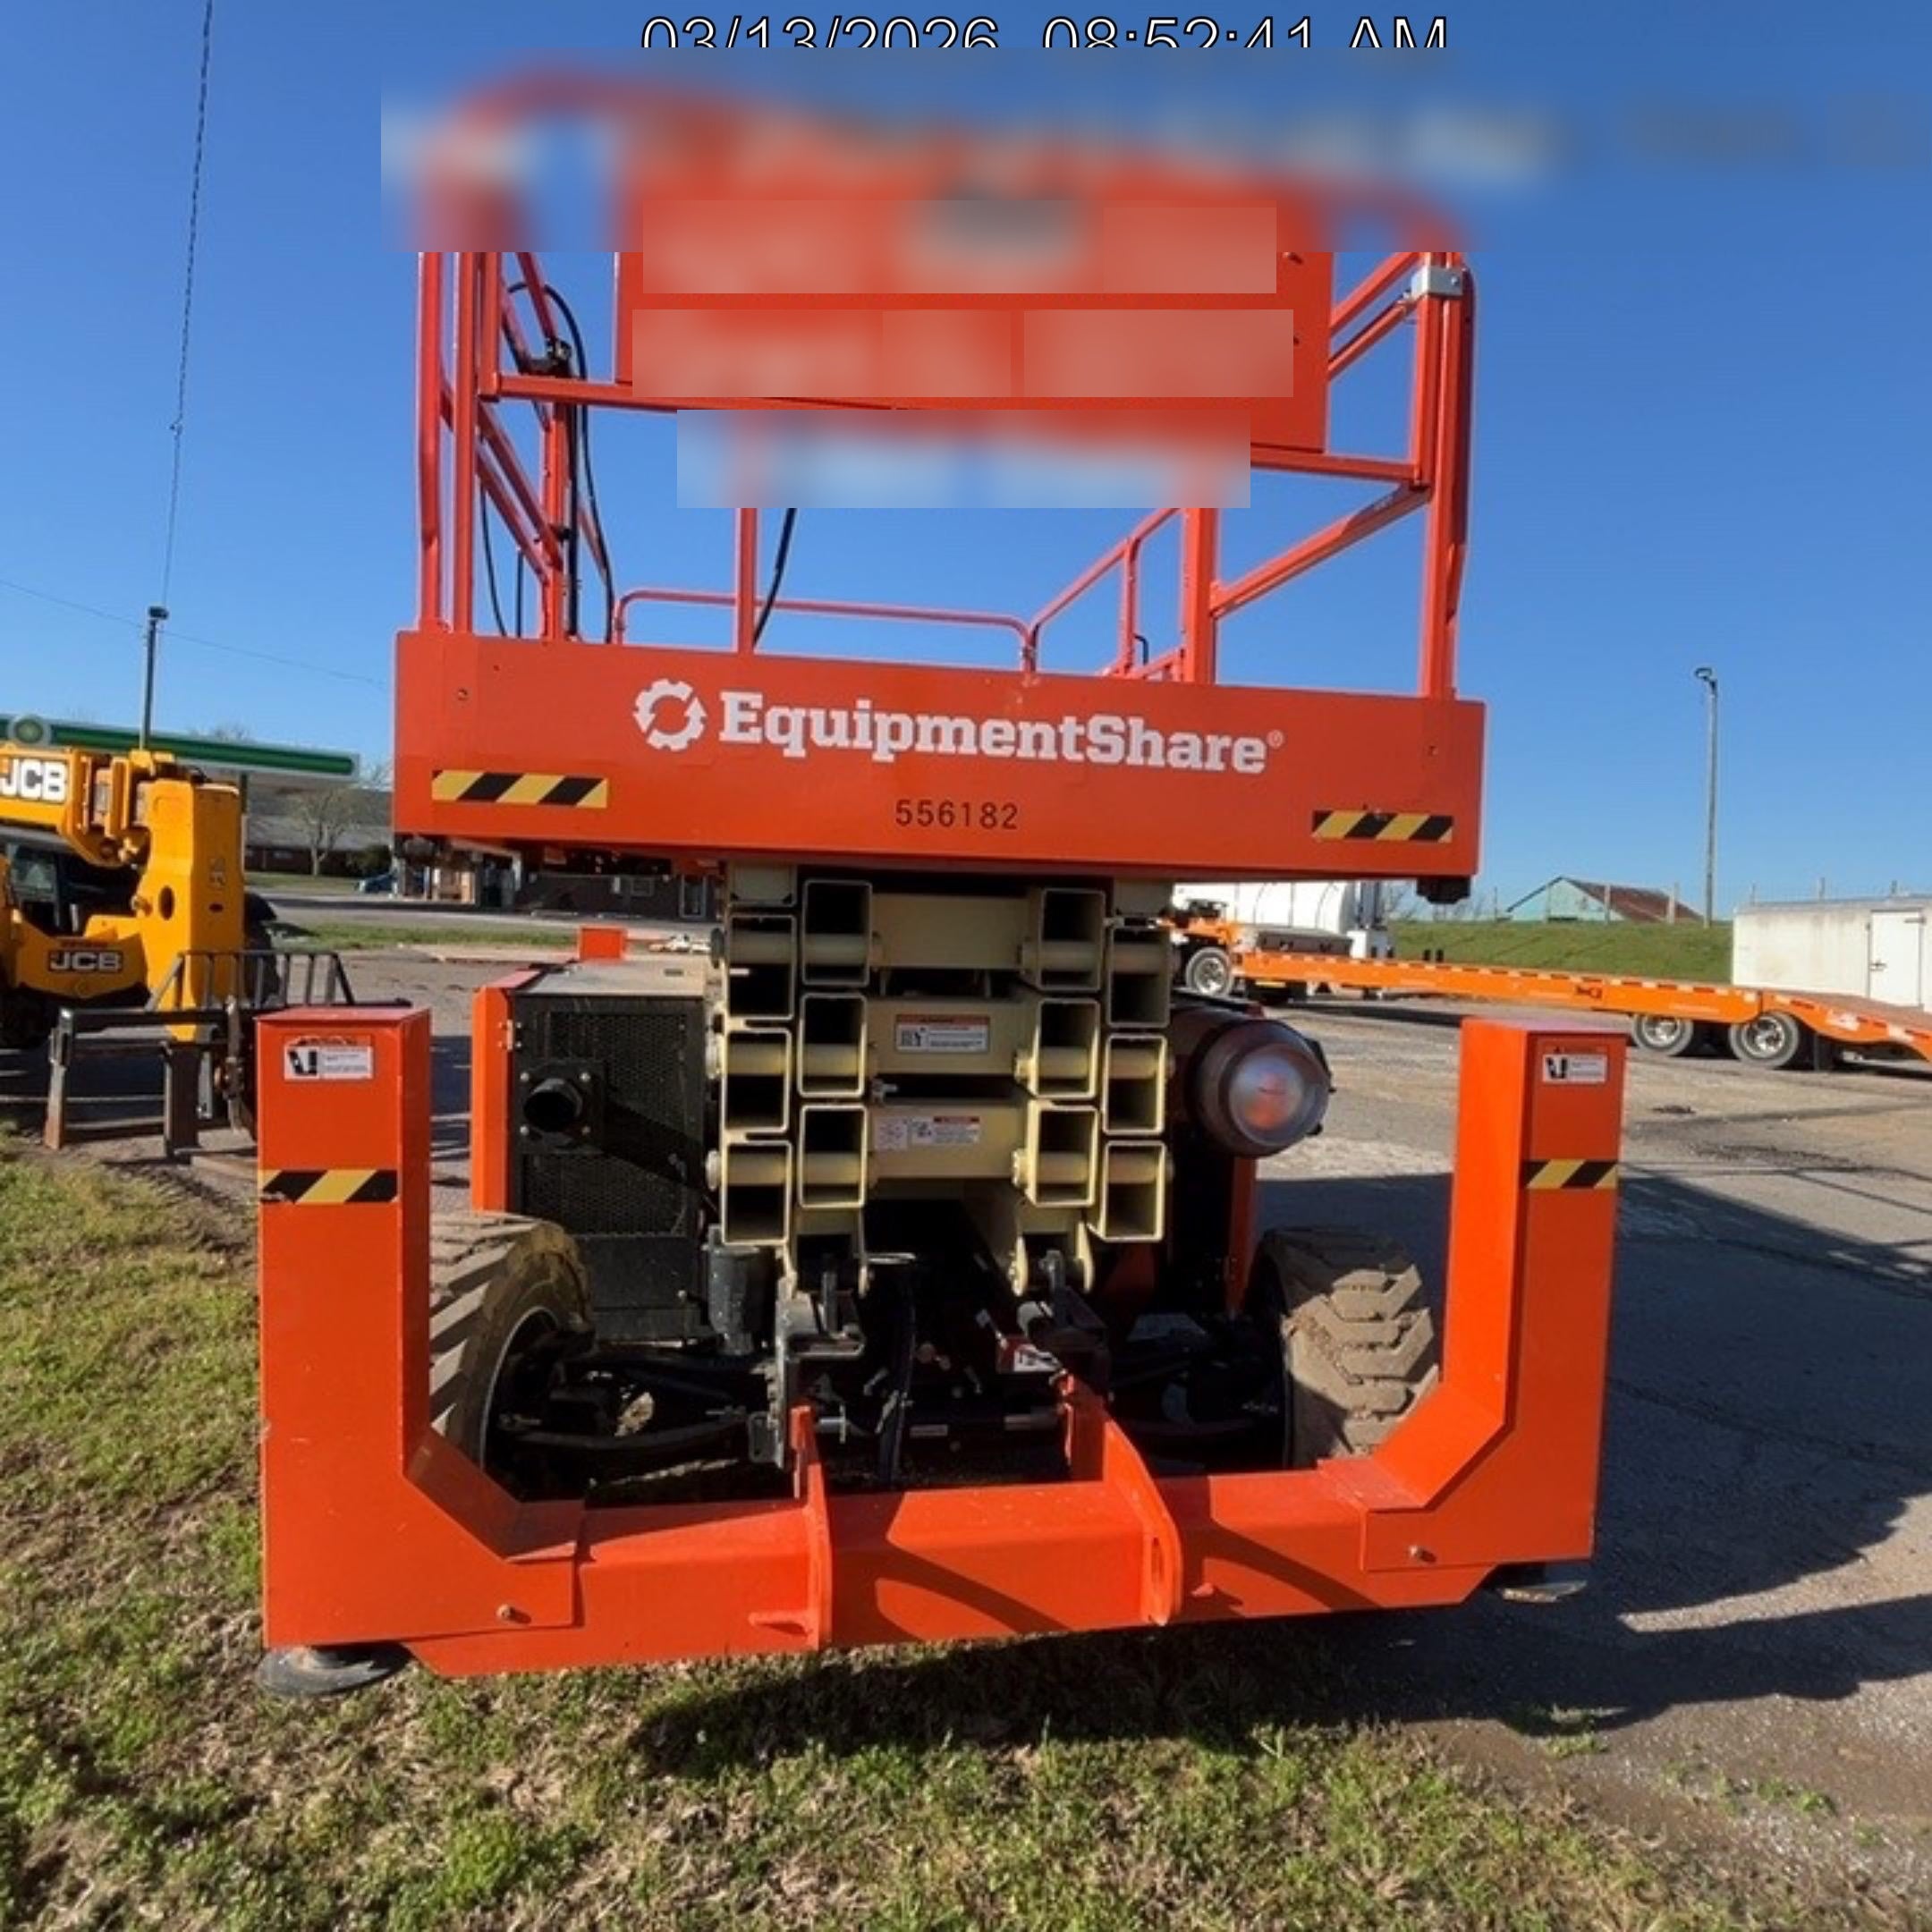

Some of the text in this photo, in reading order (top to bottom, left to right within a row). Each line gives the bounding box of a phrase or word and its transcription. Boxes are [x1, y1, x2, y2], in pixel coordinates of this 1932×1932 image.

[0, 758, 68, 802] JCB
[894, 798, 1018, 830] 556182
[50, 951, 122, 971] JCB
